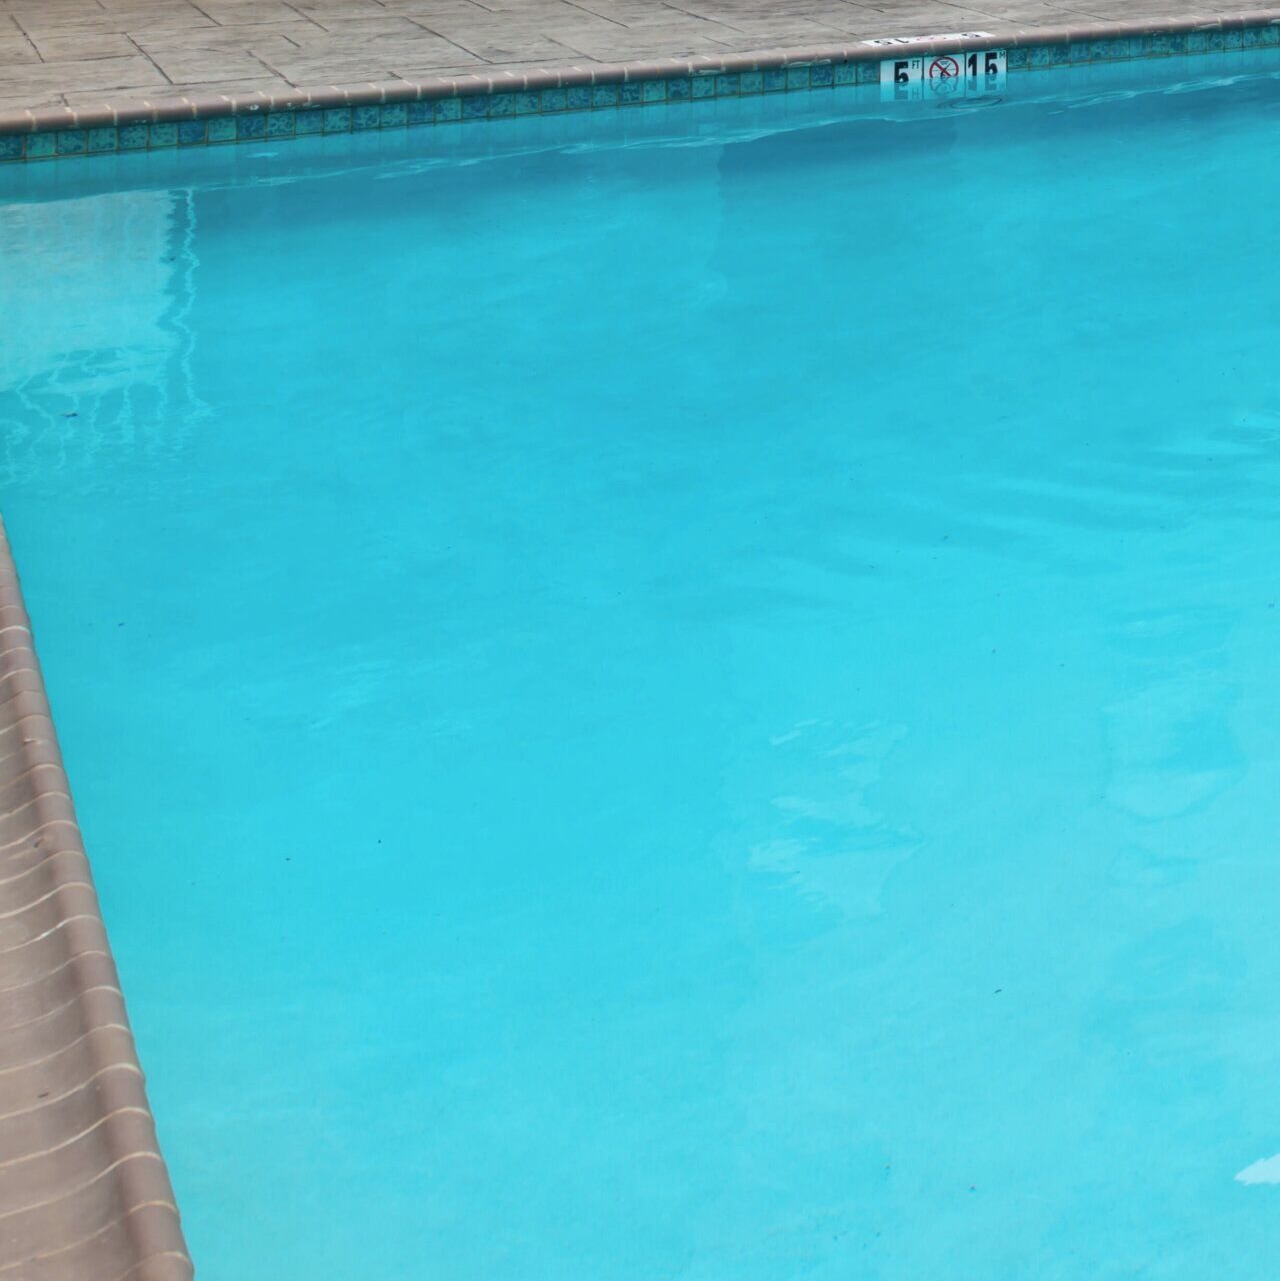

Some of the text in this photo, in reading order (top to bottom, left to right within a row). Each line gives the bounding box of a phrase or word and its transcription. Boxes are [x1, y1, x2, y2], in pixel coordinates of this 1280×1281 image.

[894, 61, 909, 83] 5
[912, 60, 920, 69] FT
[1000, 50, 1006, 59] M
